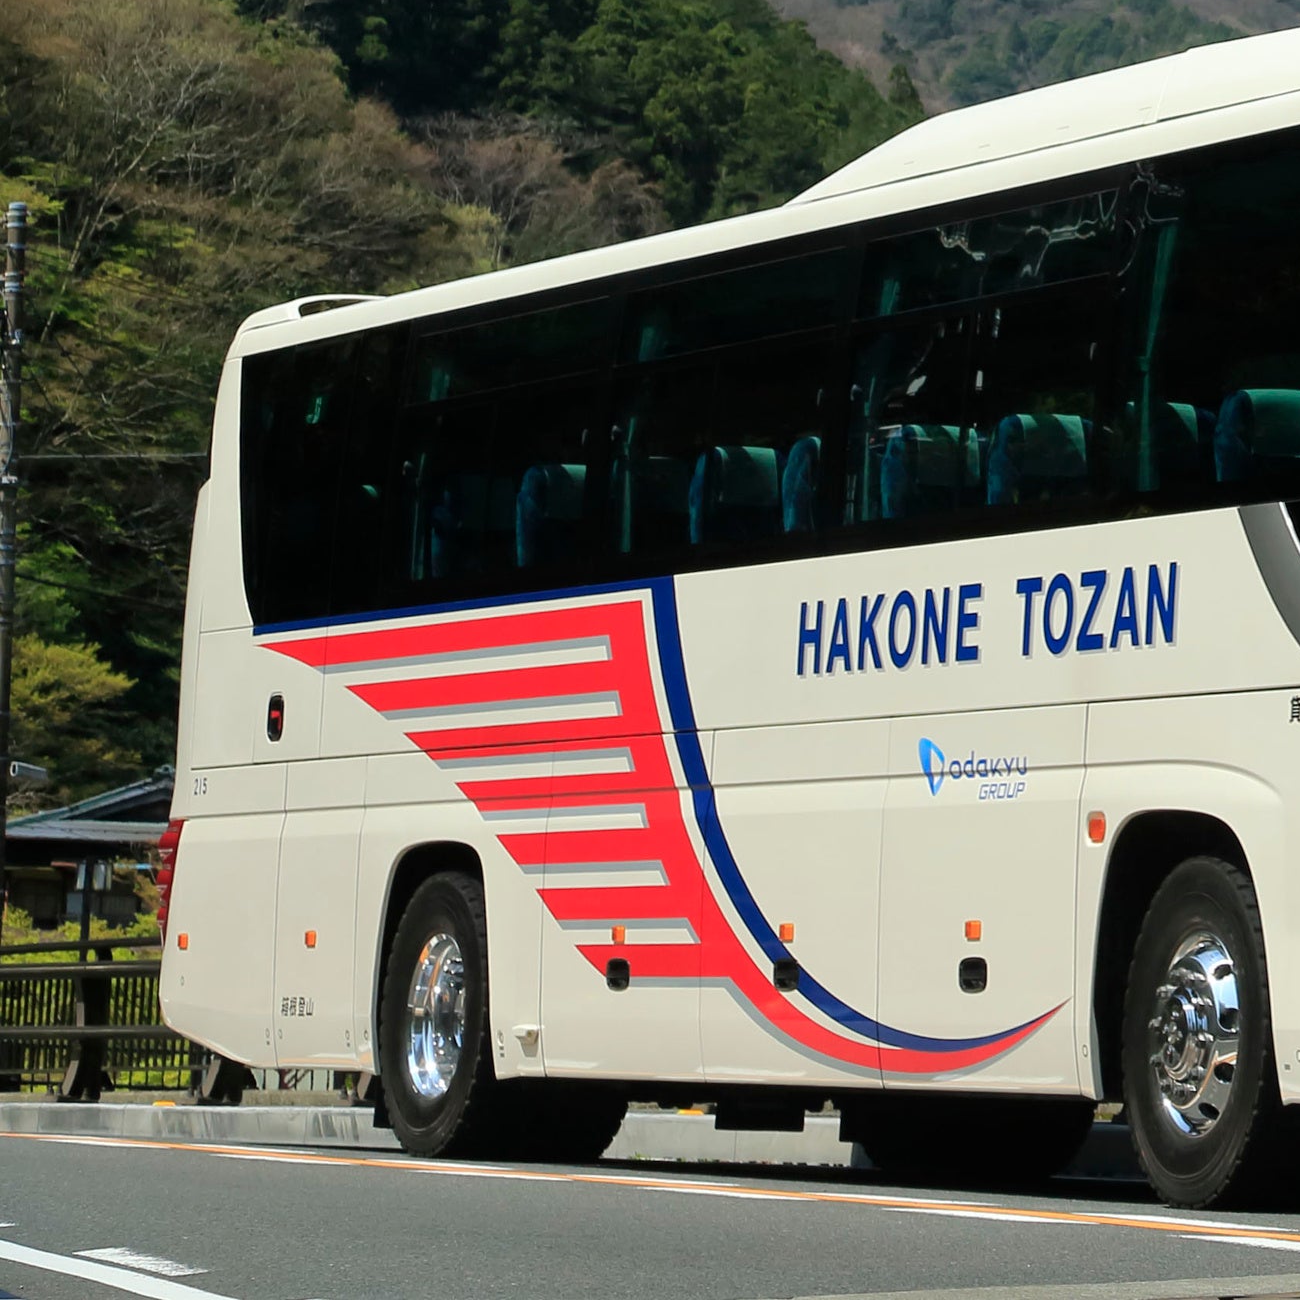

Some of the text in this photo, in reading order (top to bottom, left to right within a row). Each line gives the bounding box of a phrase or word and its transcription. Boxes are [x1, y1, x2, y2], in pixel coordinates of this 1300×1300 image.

[797, 561, 1180, 676] HAKONE TOZAN
[949, 750, 1027, 779] odakyu
[193, 777, 208, 796] 215
[978, 782, 1026, 800] GROUP
